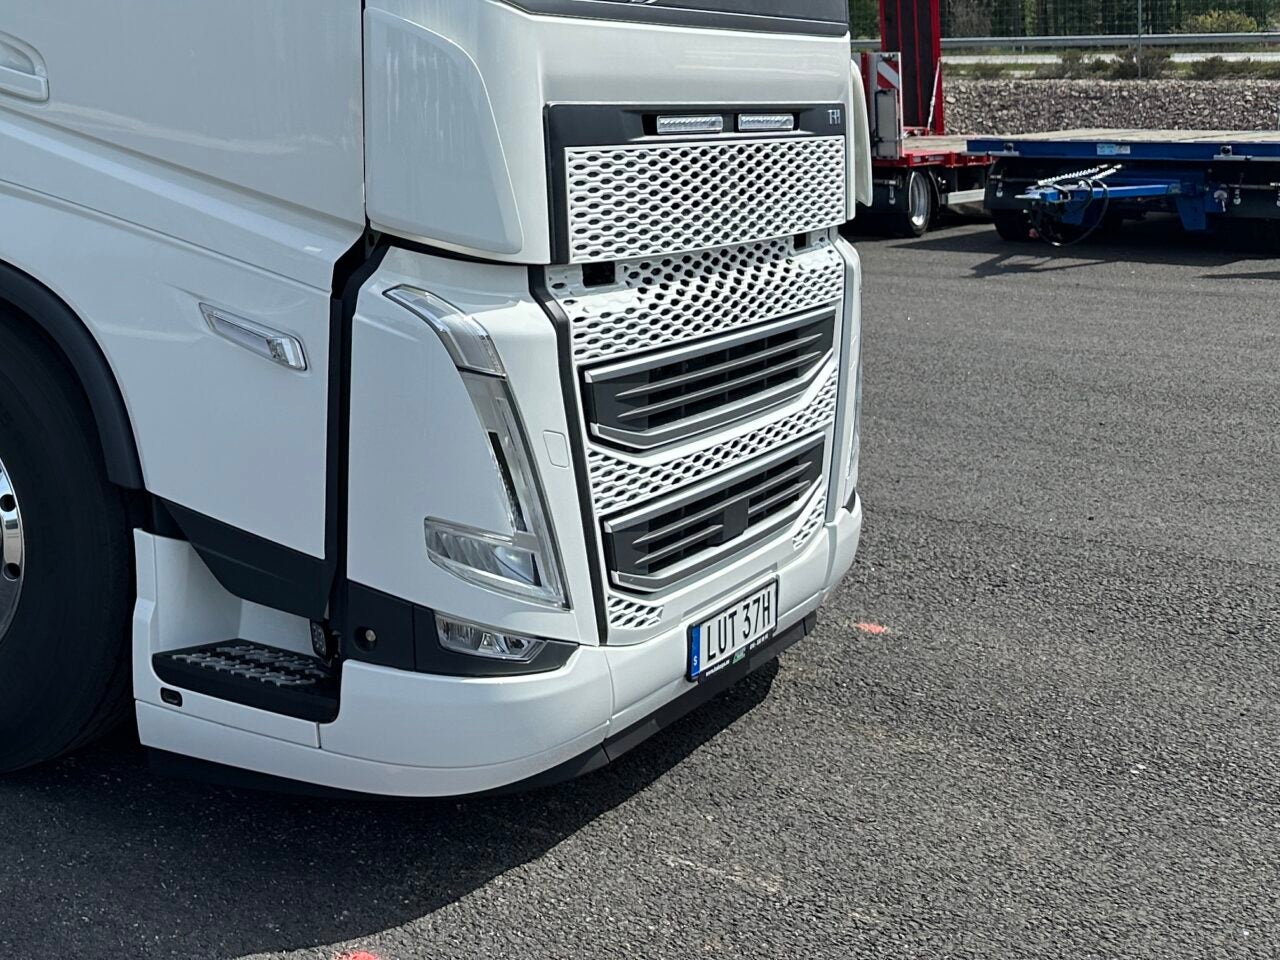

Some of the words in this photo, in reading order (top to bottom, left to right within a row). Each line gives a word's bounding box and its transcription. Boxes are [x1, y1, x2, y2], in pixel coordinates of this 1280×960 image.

[707, 610, 738, 662] LUT
[743, 590, 771, 639] 37H
[693, 655, 698, 666] S
